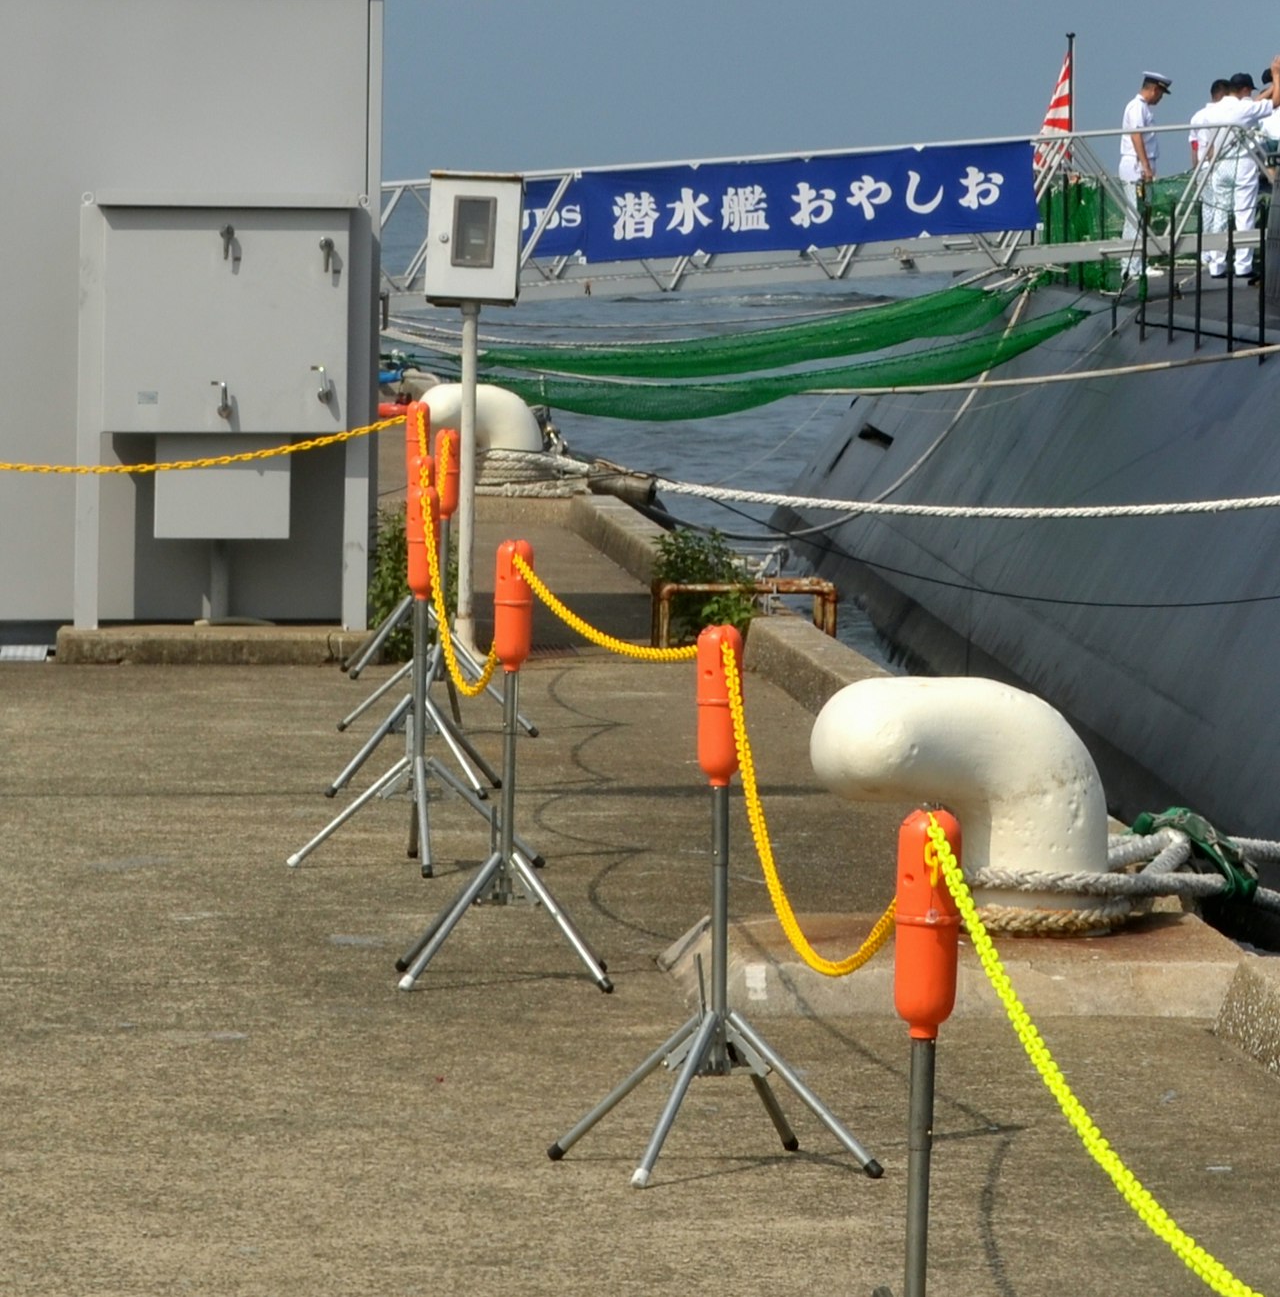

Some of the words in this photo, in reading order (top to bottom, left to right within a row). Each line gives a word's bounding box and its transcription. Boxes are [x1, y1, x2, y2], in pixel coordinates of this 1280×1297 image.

[612, 184, 770, 241] 潜水艦
[789, 165, 1005, 229] おやしお
